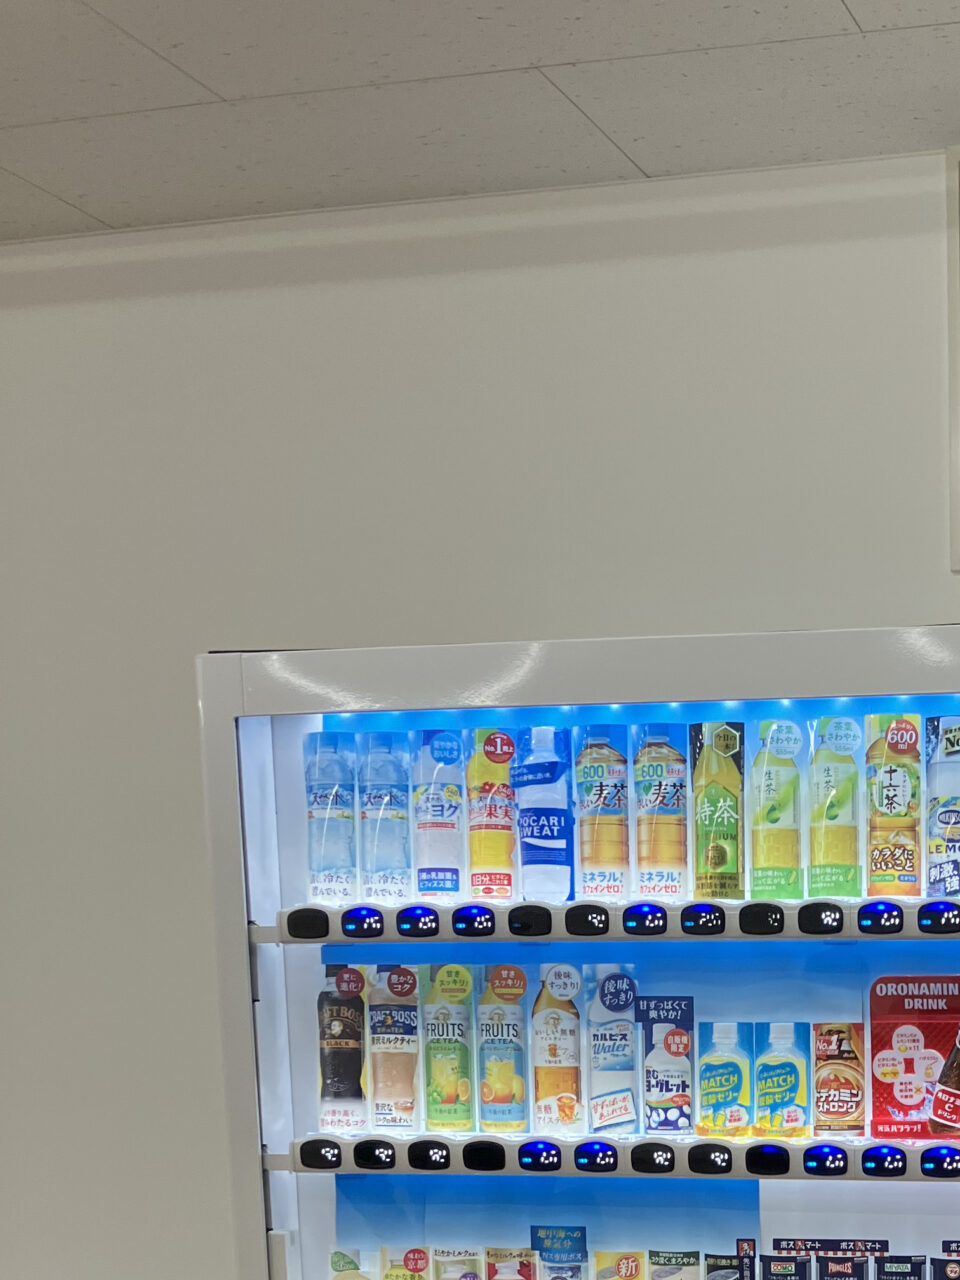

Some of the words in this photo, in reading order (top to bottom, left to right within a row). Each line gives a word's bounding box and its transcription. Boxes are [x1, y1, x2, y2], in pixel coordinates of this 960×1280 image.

[889, 730, 917, 743] 600
[583, 765, 604, 779] 600
[641, 764, 663, 779] 600
[883, 766, 901, 814] 十六茶
[696, 797, 740, 825] 特茶
[872, 847, 914, 859] カラダに
[872, 859, 914, 871] いいこと
[582, 872, 624, 883] ミネラル!
[640, 872, 682, 883] ミネラル!
[393, 984, 411, 992] コク
[604, 978, 630, 993] 後味
[603, 991, 634, 1006] すっきり
[640, 1000, 688, 1010] 甘ずっぱくて
[905, 999, 947, 1010] DRINK
[392, 1011, 417, 1026] BOSS
[426, 1023, 464, 1037] FRUITS
[481, 1023, 519, 1038] FRUITS
[593, 1033, 628, 1042] カルピス
[593, 1042, 629, 1055] Water
[701, 1074, 738, 1089] MATCH
[758, 1074, 795, 1089] MATCH
[818, 1102, 856, 1113] ストロング
[619, 1257, 637, 1277] 新
[829, 1262, 852, 1273] PRINGLES
